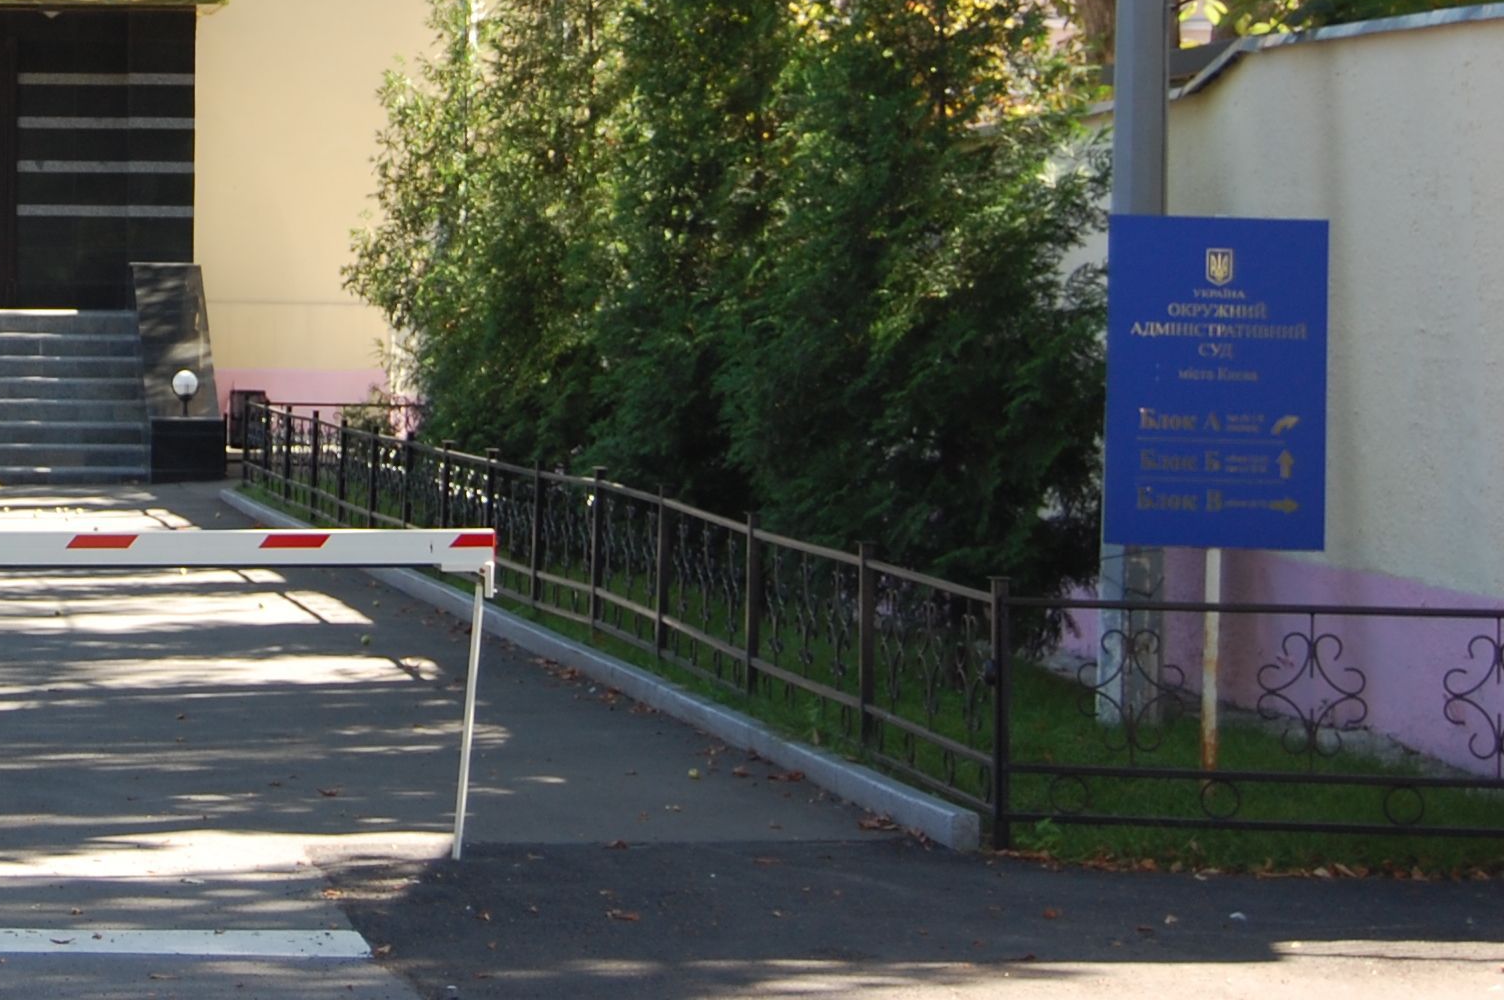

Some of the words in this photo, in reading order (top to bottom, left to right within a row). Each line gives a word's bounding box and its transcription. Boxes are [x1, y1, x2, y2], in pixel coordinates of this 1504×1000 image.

[1168, 303, 1267, 318] ОКРУЖНИЙ
[1130, 321, 1307, 339] АДМІНІСТРАТИВНИЙ
[1197, 343, 1234, 359] СУД
[1140, 408, 1197, 430] Блок
[1204, 412, 1220, 432] А
